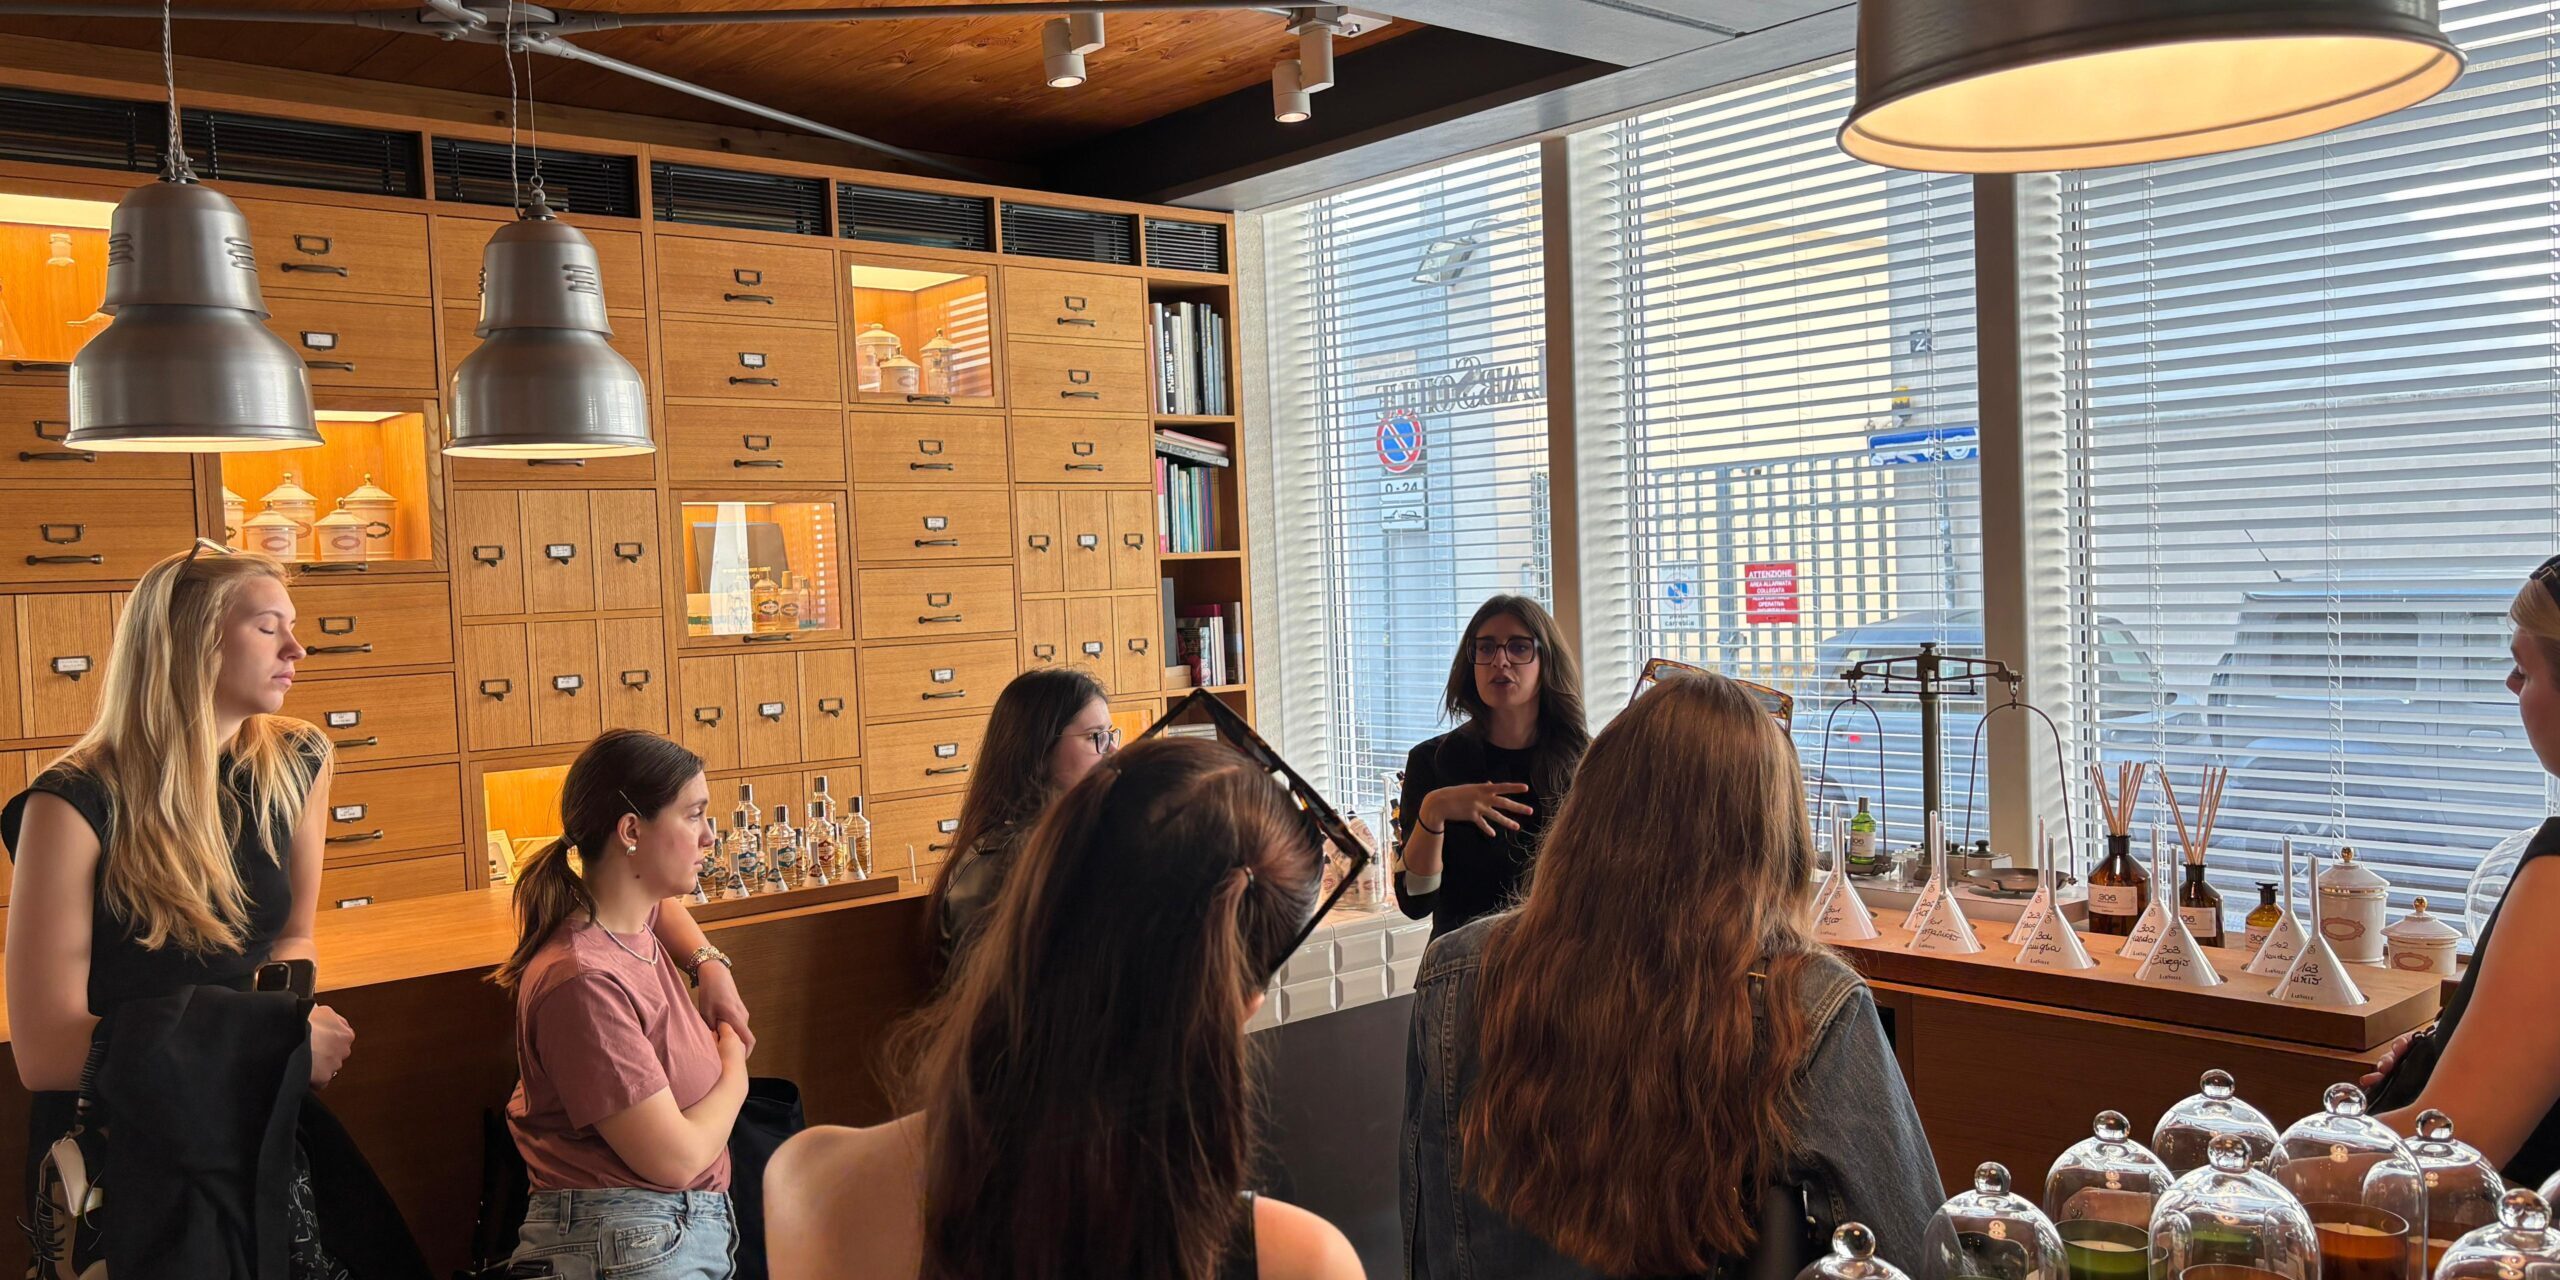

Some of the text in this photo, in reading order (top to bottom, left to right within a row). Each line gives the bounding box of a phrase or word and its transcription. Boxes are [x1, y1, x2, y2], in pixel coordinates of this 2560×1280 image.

[1748, 569, 1793, 579] ATTENZIONE
[2180, 914, 2196, 923] 06
[2159, 945, 2181, 954] 303
